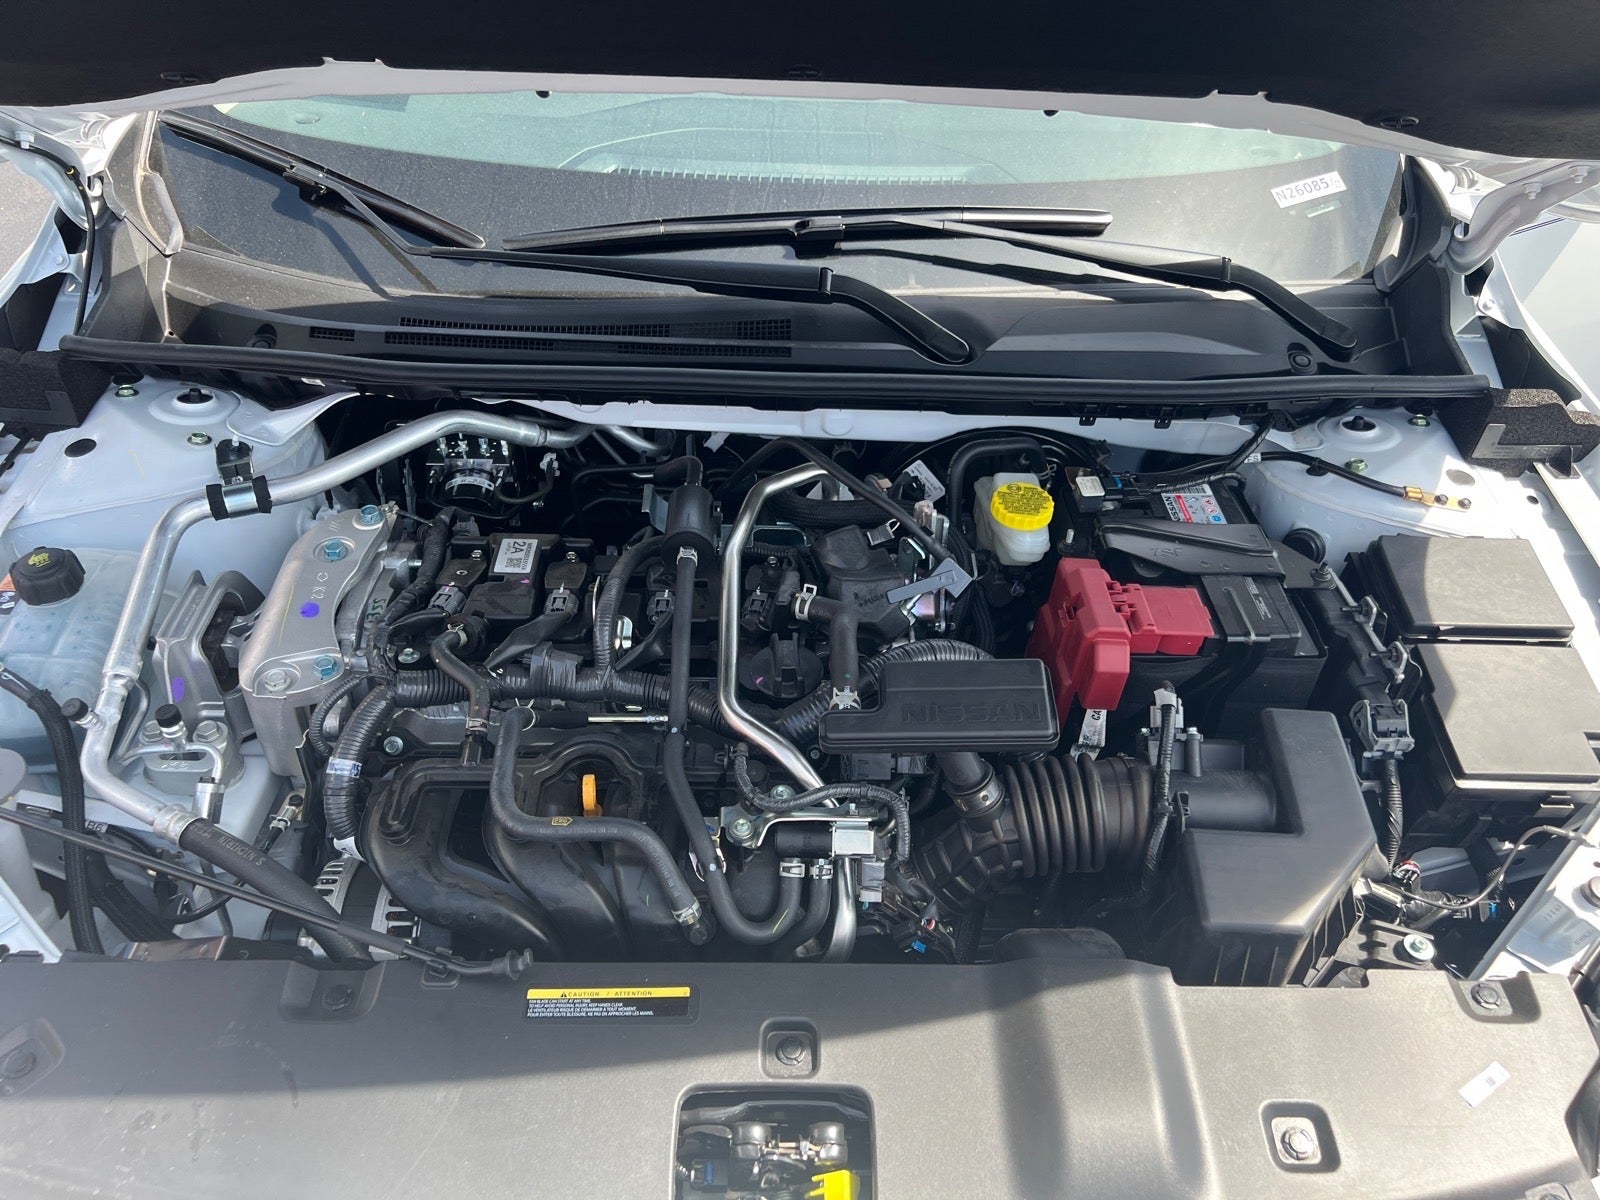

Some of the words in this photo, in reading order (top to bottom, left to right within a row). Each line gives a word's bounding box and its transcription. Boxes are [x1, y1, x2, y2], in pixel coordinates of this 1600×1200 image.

[1275, 177, 1330, 202] N26085
[511, 541, 526, 554] 2A
[902, 702, 1042, 723] NISSAN
